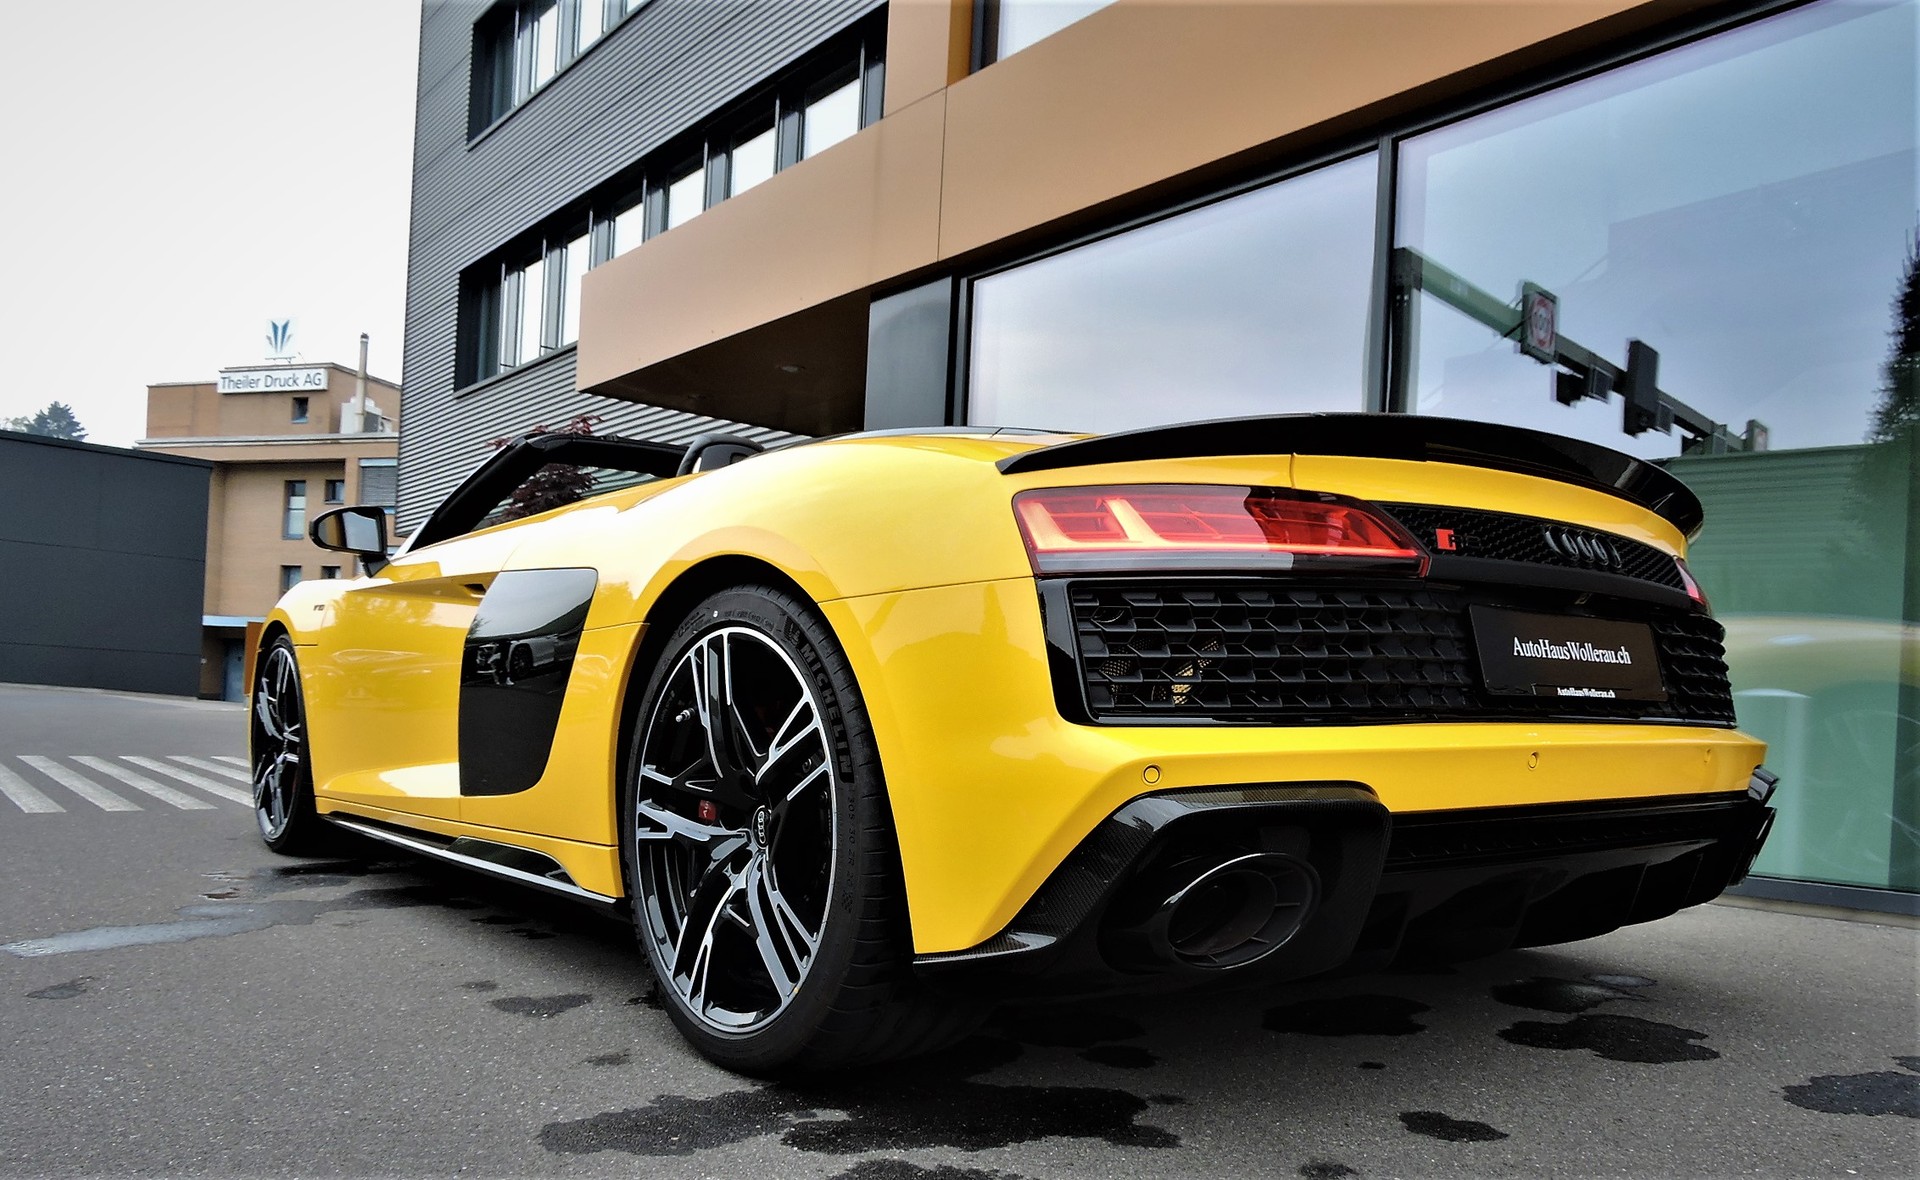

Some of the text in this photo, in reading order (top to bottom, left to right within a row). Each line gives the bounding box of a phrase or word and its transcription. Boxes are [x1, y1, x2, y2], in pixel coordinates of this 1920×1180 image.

[220, 373, 322, 389] Theiler Druck AG
[1513, 637, 1632, 664] AutoHausWollerau.ch
[801, 643, 852, 773] MICHELIN
